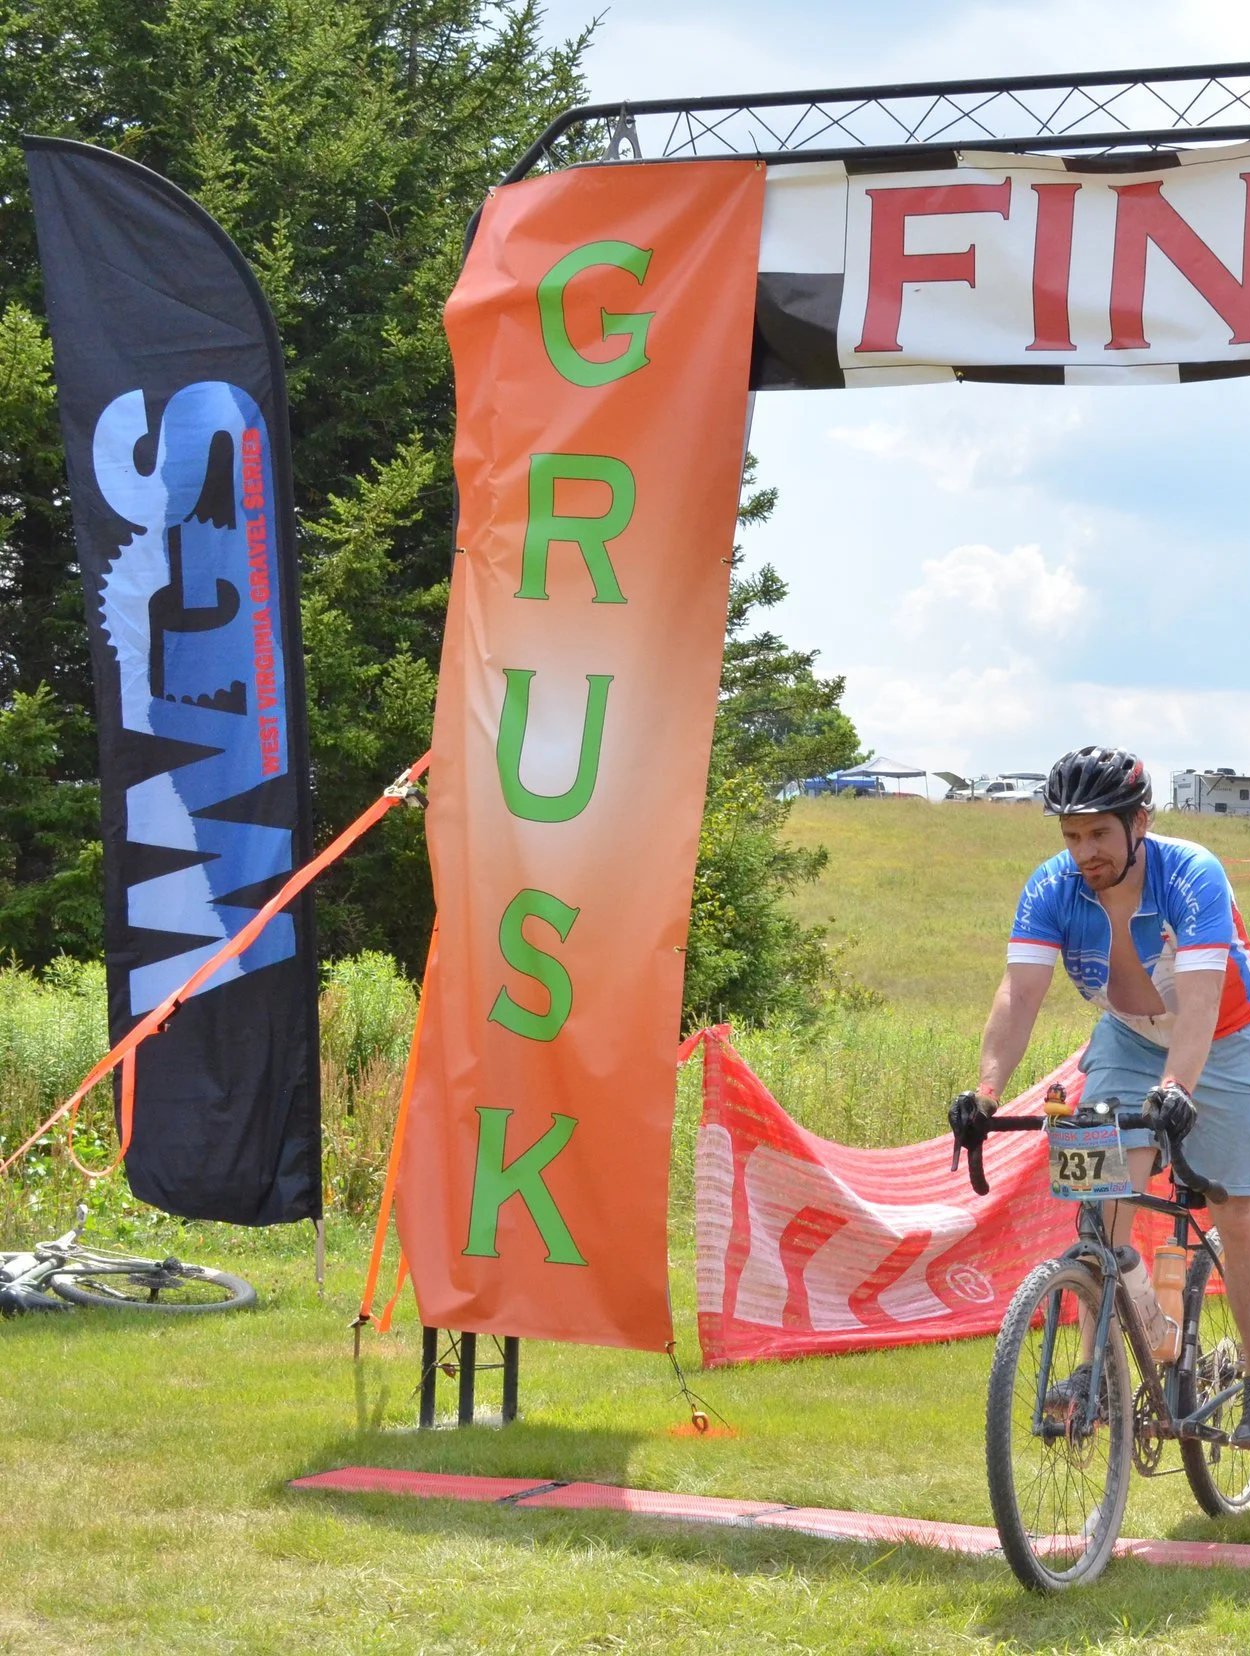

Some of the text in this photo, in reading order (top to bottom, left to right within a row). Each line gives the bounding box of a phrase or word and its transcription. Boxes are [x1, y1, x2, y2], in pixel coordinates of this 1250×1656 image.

[241, 428, 281, 777] WEST VIRGINIA GRAVEL SERIES
[461, 240, 654, 1267] GRUSK
[1058, 1150, 1106, 1181] 237
[1083, 1129, 1117, 1141] 2024
